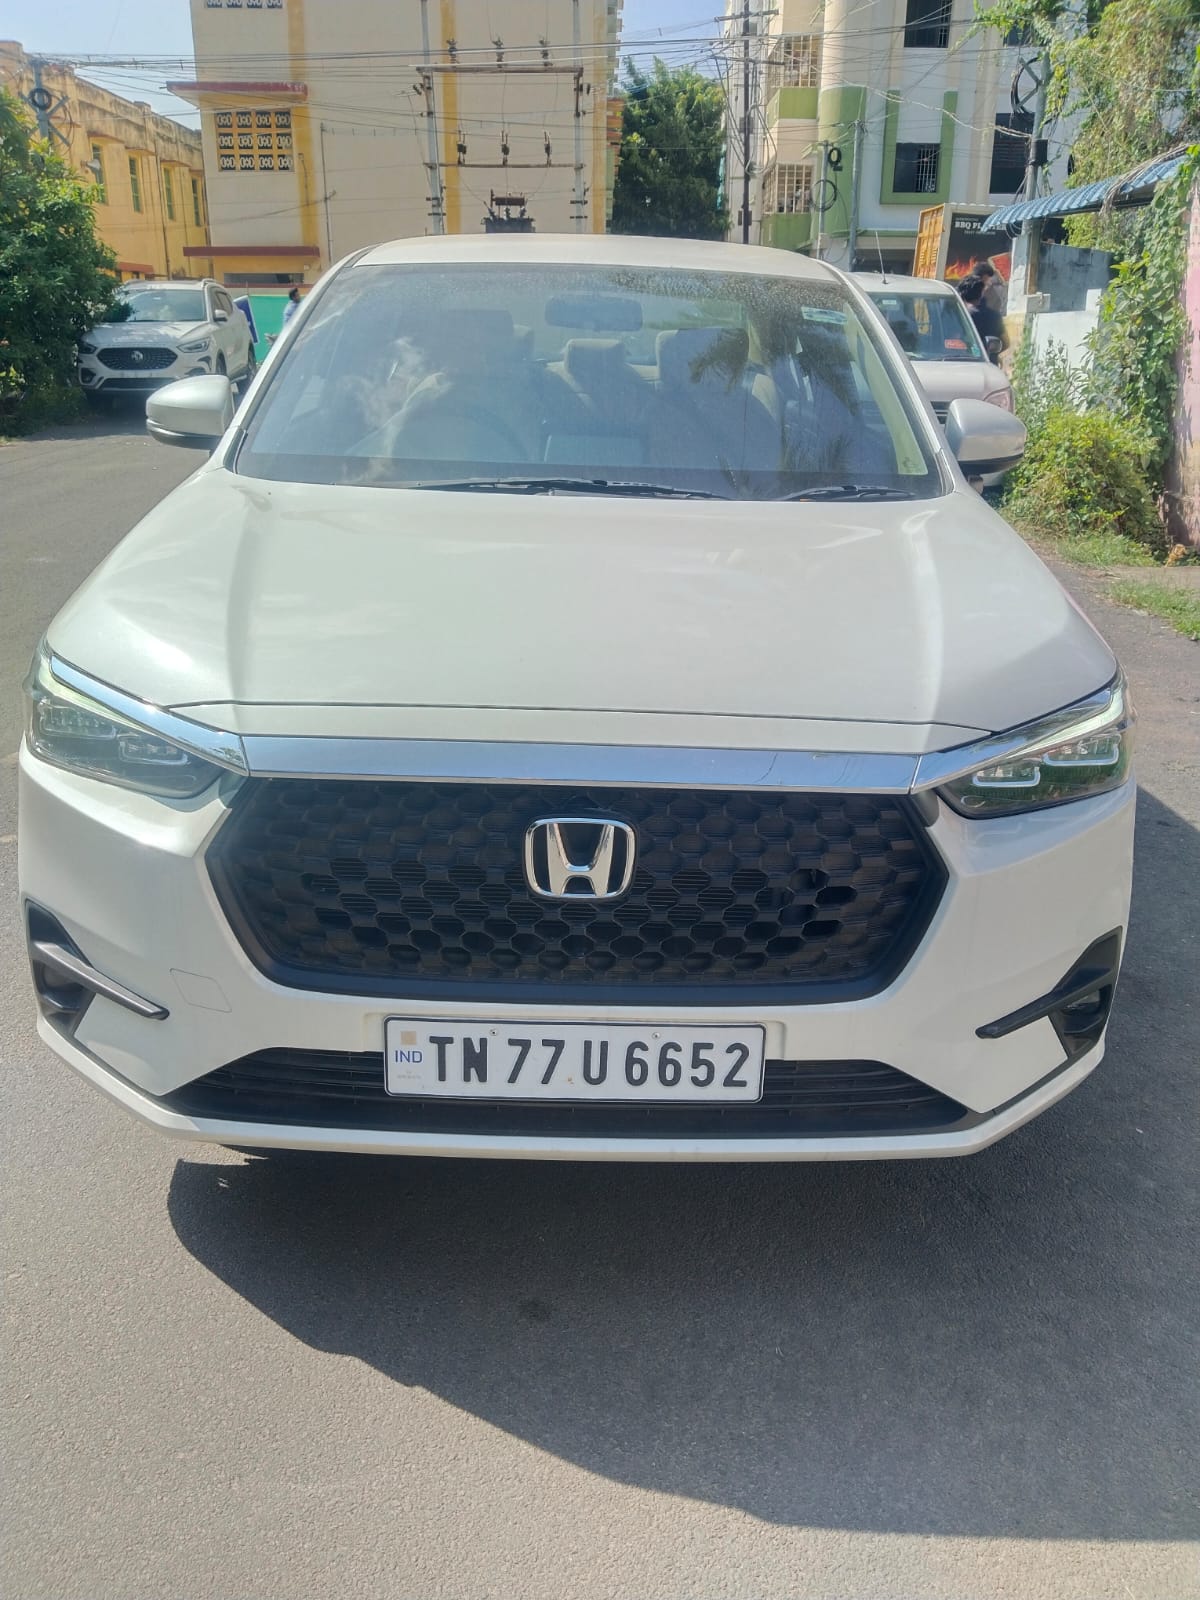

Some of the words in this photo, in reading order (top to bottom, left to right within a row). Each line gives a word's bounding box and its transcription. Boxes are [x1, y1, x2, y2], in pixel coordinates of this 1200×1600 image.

[955, 221, 971, 229] BBQ
[395, 1050, 423, 1063] IND
[429, 1036, 488, 1083] TN
[507, 1038, 565, 1085] 77
[583, 1040, 608, 1085] U
[625, 1041, 750, 1088] 6652
